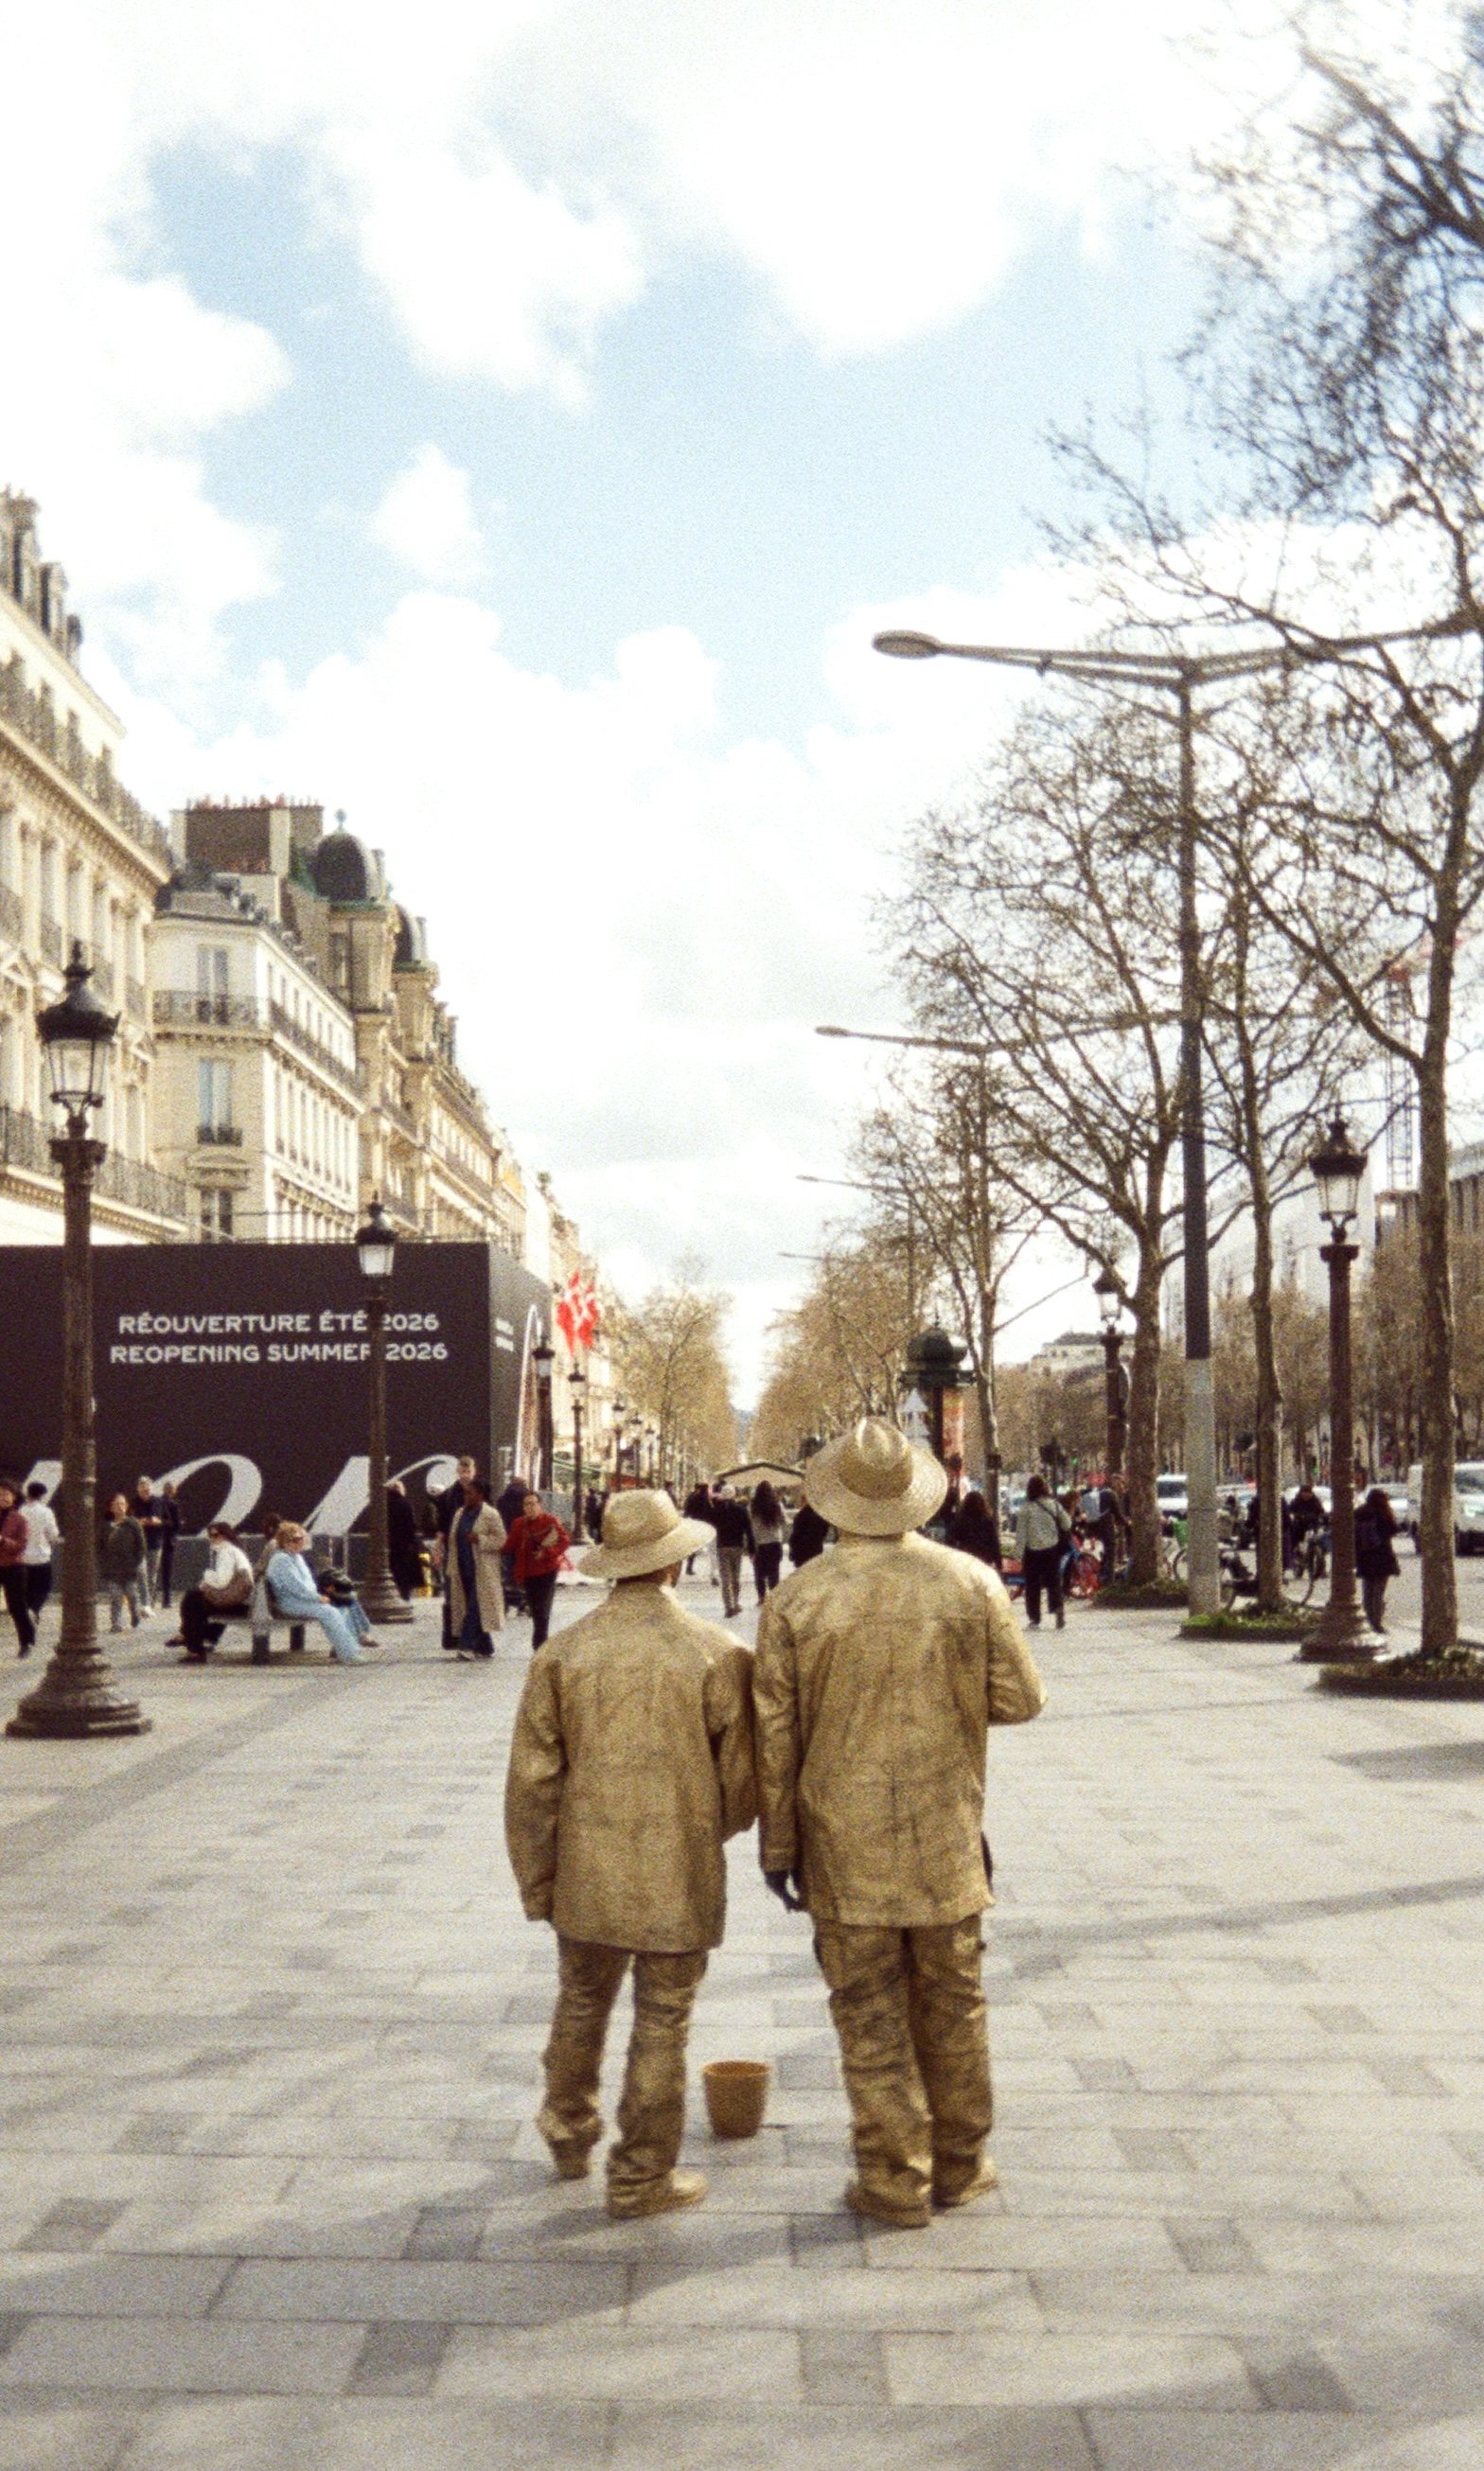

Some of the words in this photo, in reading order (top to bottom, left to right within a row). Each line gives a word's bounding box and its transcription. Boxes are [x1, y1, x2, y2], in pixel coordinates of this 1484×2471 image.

[118, 1311, 311, 1333] RÉOUVERTURE
[319, 1310, 368, 1332] ÉTÉ
[382, 1314, 440, 1332] 2026
[110, 1344, 260, 1364] REOPENING
[385, 1342, 448, 1361] 2026
